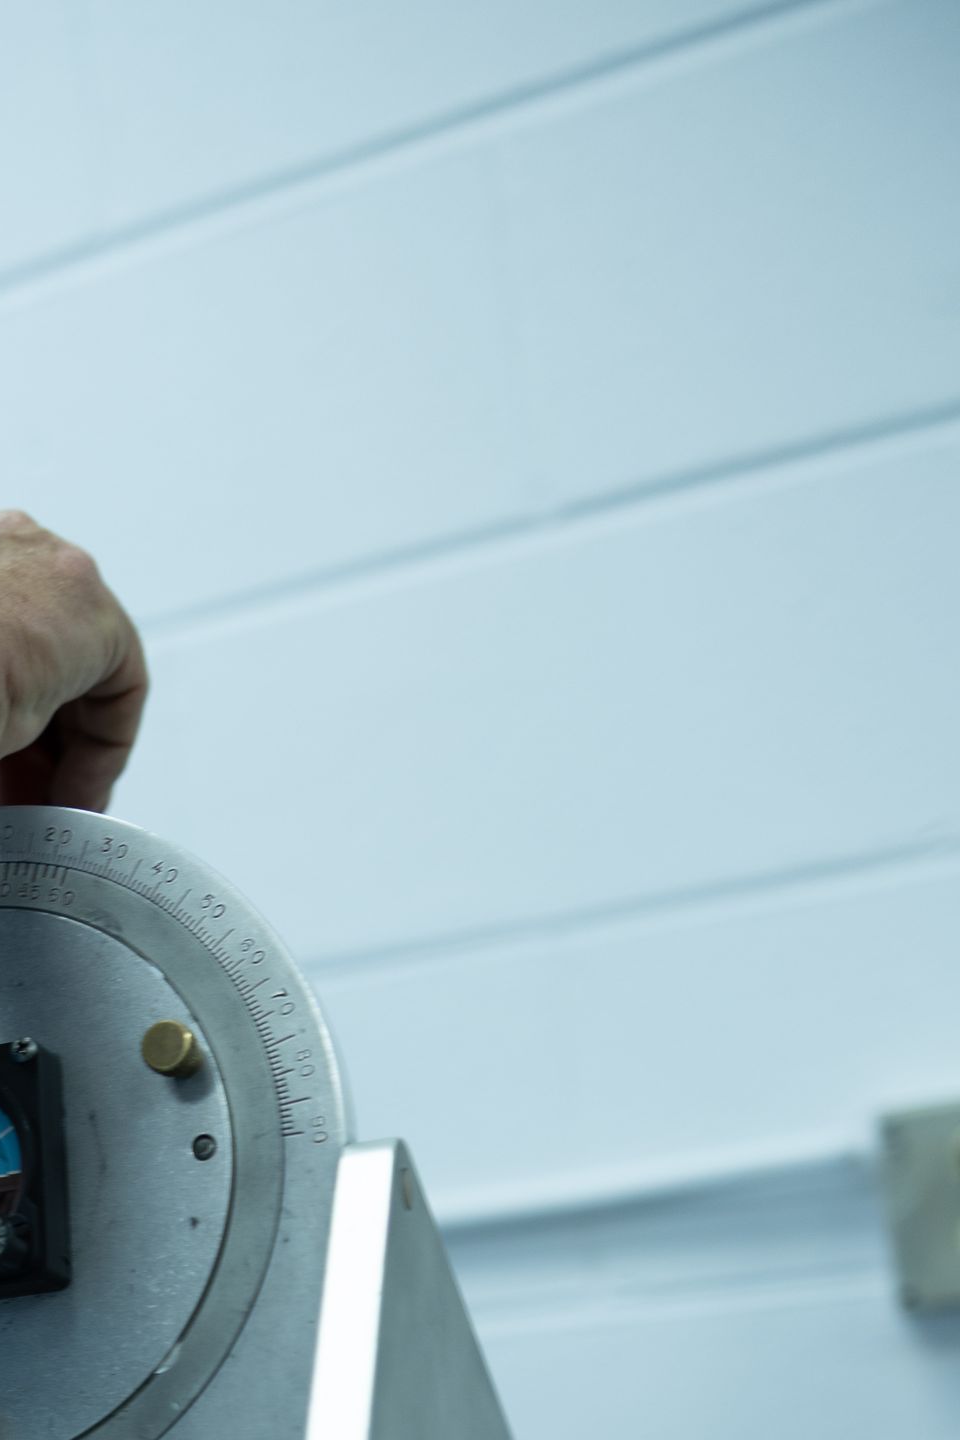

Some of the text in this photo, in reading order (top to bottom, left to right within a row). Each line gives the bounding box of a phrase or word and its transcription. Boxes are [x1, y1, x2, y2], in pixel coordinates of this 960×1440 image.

[44, 826, 73, 845] 20
[101, 837, 128, 859] 30
[151, 861, 179, 883] 40
[200, 894, 226, 919] 50
[240, 938, 266, 965] 60
[271, 988, 296, 1016] 70
[296, 1049, 316, 1078] 80
[311, 1115, 329, 1144] 90
